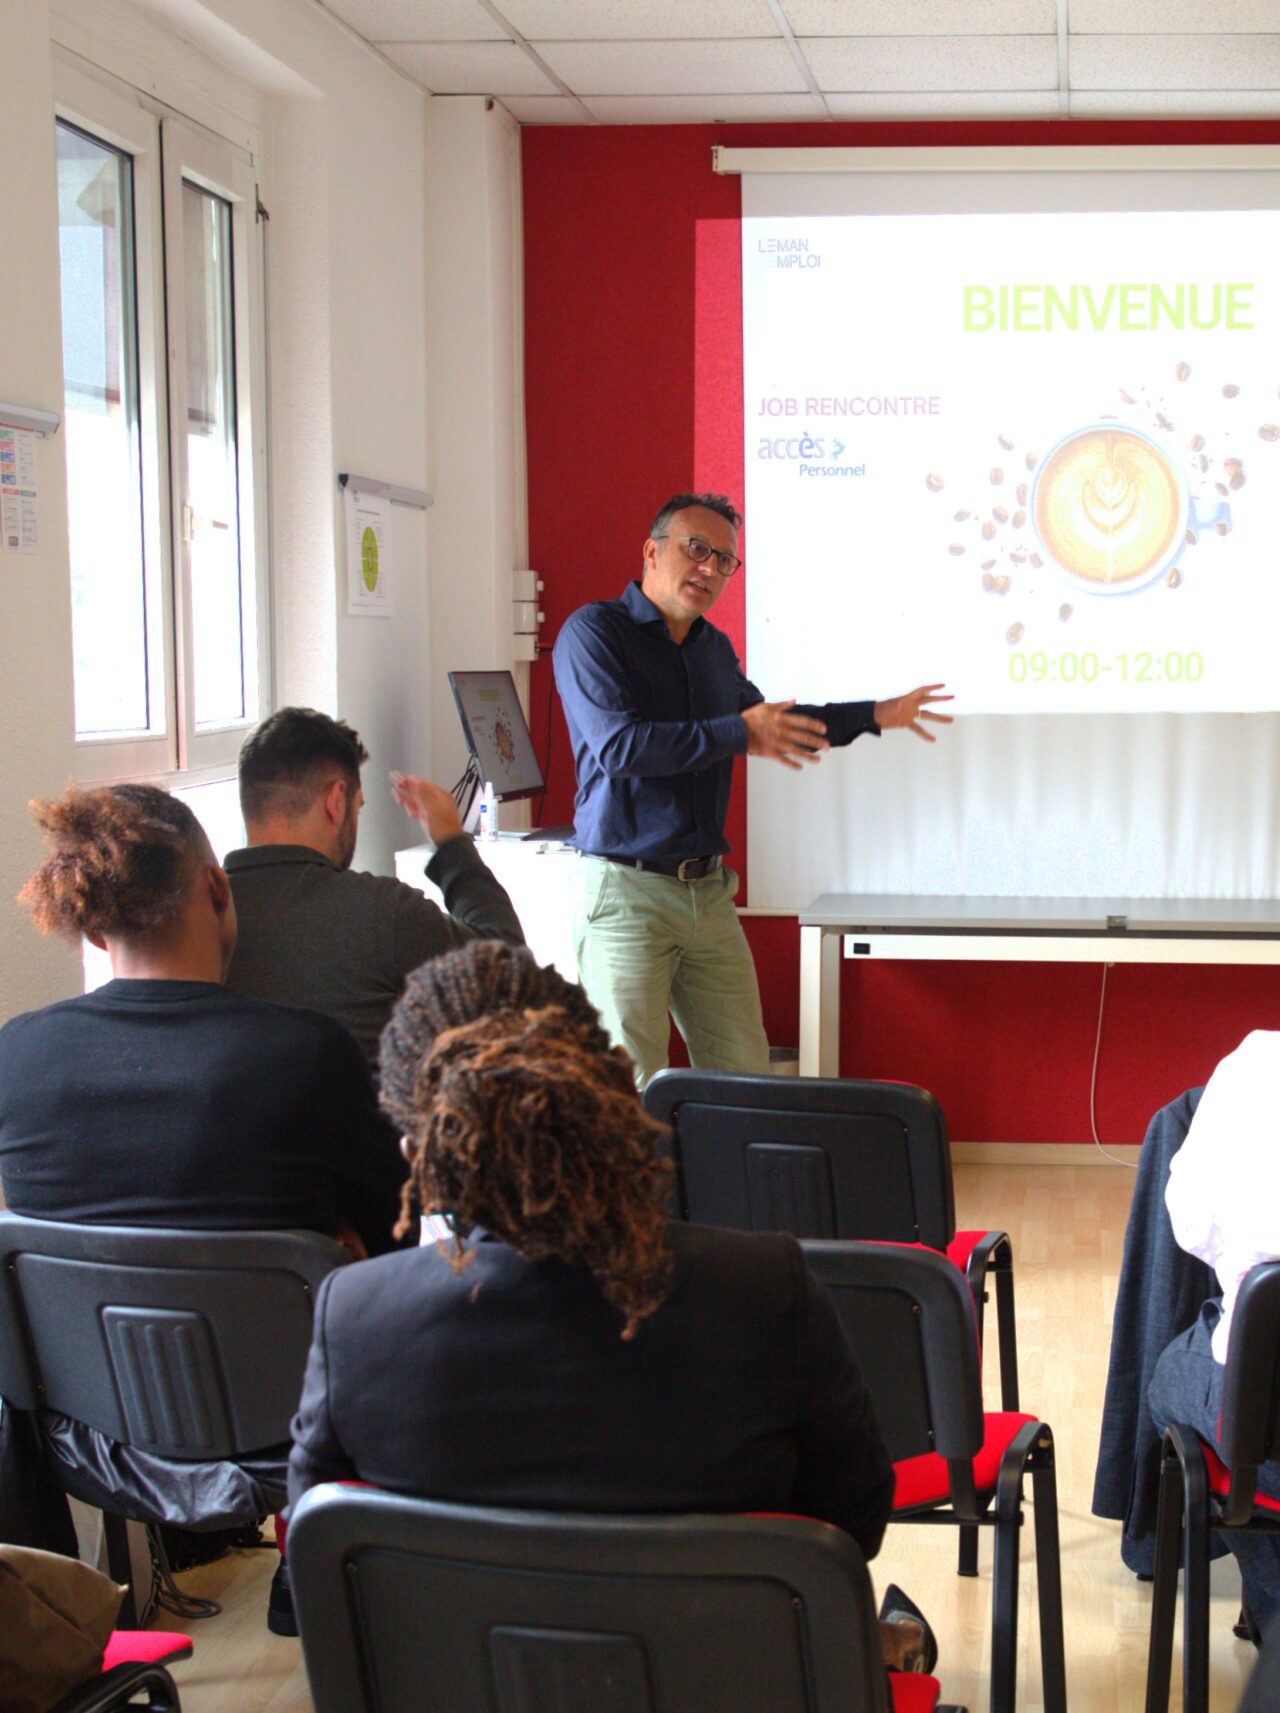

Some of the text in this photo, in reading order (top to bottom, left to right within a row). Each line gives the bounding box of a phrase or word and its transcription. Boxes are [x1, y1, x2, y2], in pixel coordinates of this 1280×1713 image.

[758, 238, 809, 253] LEMAN
[962, 283, 1255, 332] BIENVENUE
[758, 396, 941, 416] JOB RENCONTRE
[757, 431, 826, 460] accès
[799, 463, 865, 477] Personnel
[1008, 652, 1204, 685] 09:00-12:00
